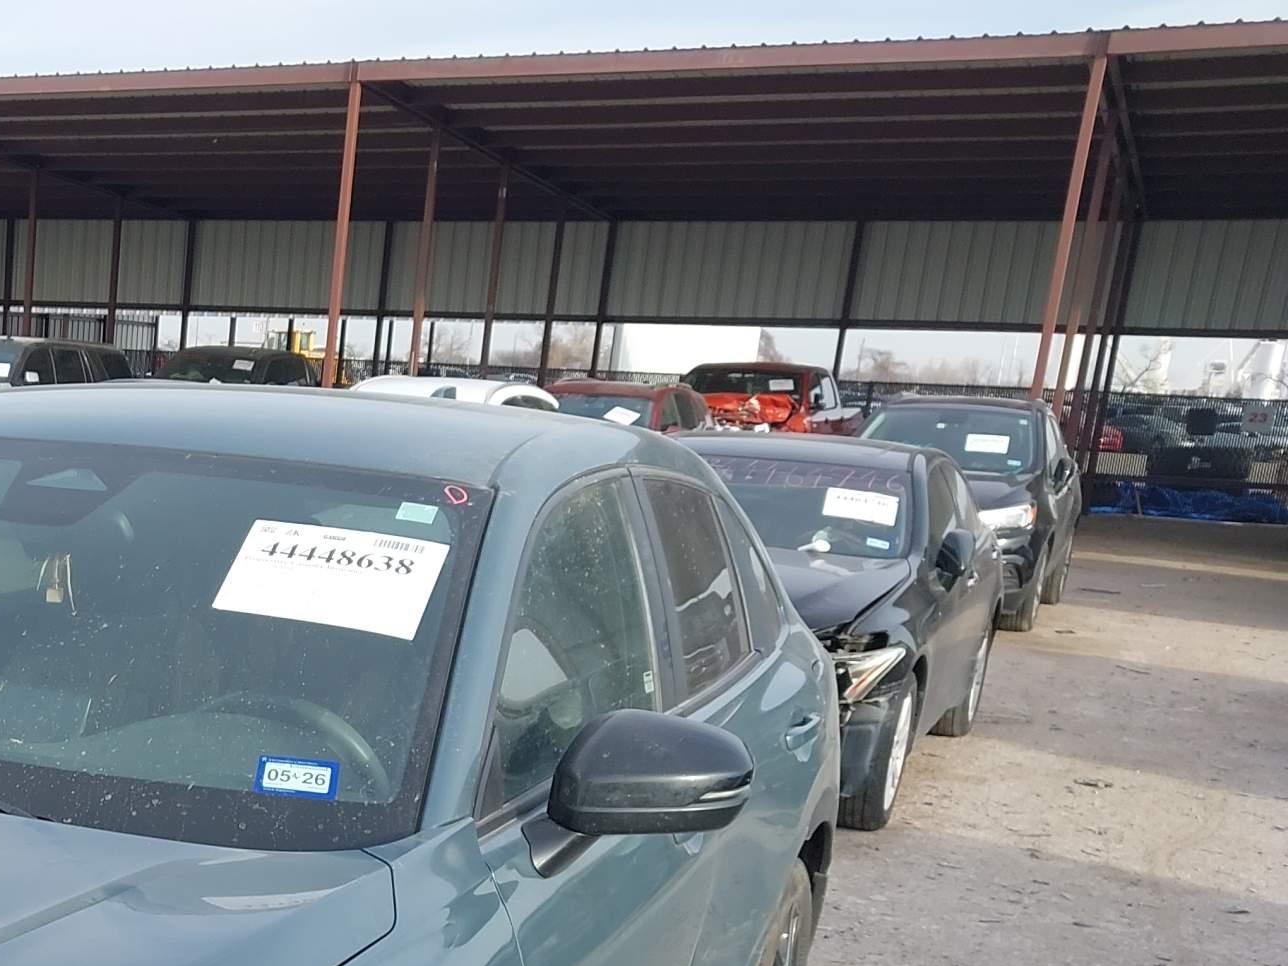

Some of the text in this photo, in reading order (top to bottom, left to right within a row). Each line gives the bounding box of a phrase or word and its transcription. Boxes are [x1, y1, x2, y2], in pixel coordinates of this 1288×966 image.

[260, 541, 415, 576] 44448638
[267, 768, 326, 786] 05 26
